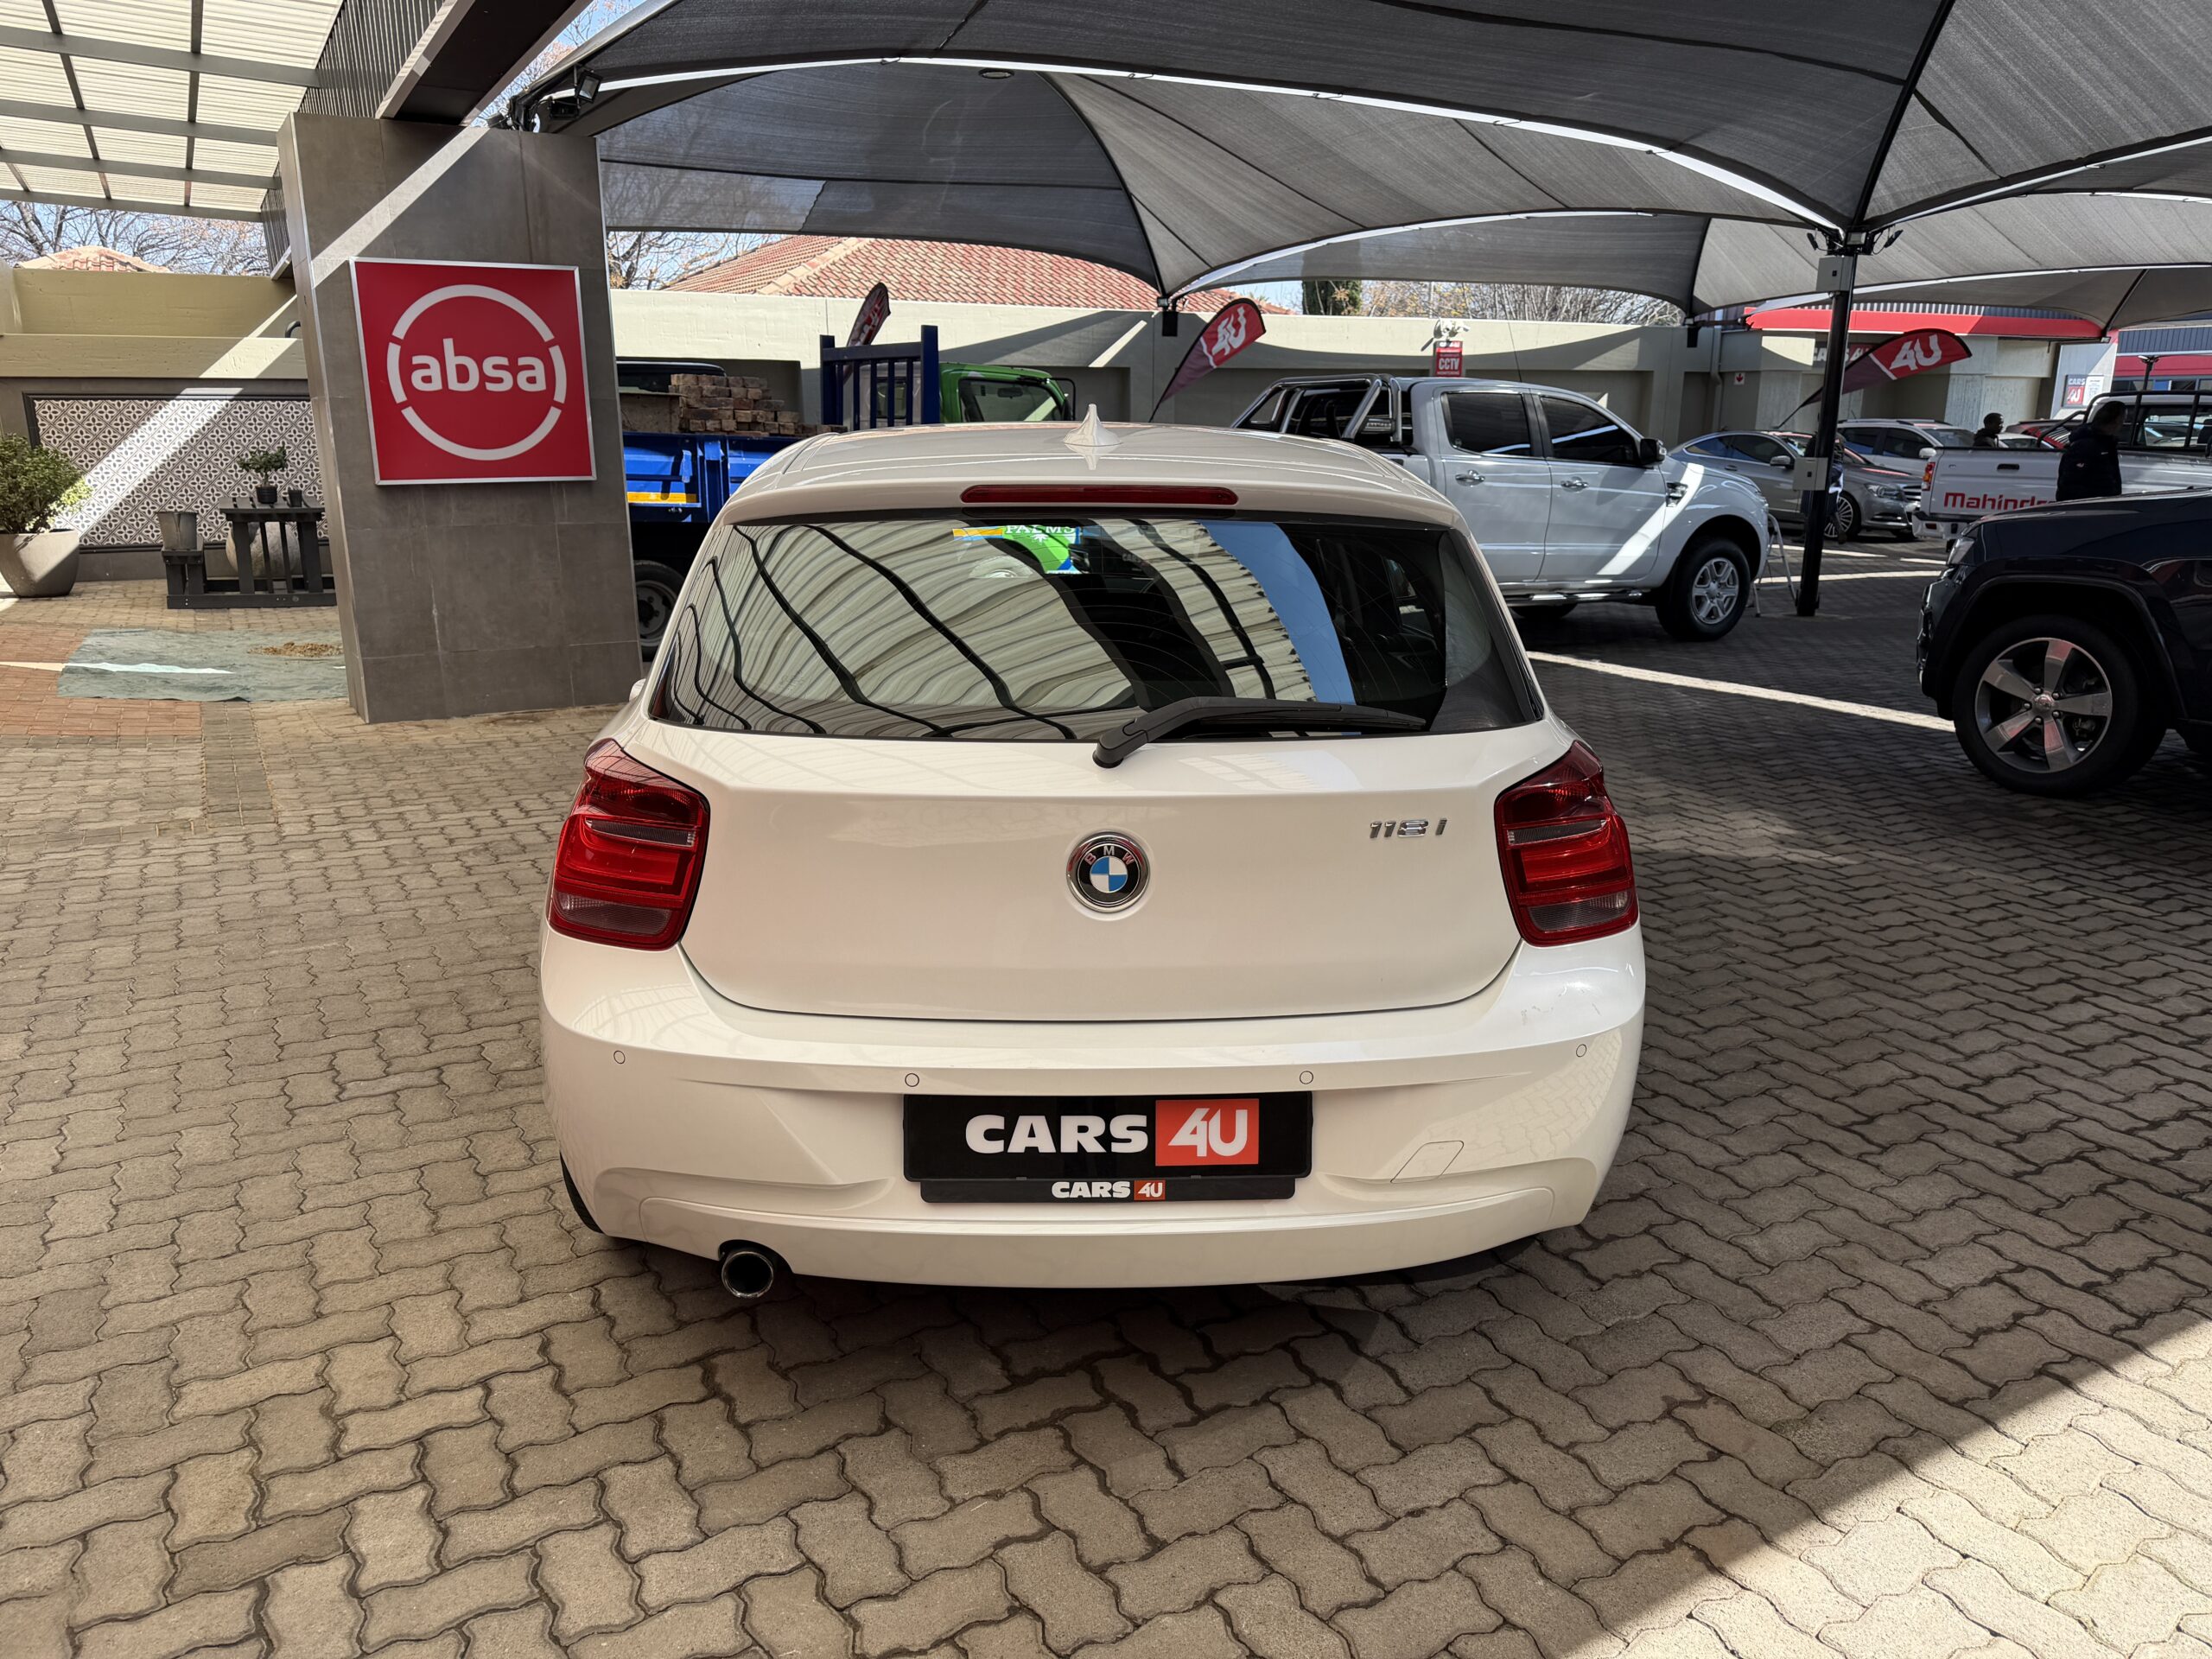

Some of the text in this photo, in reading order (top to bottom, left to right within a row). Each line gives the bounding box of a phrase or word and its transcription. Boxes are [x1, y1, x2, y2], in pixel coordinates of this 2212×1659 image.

[1212, 306, 1246, 356] 4U
[410, 338, 546, 392] absa
[1439, 358, 1460, 370] CCTV
[1890, 334, 1942, 371] 4U
[1084, 845, 1135, 865] BMW
[965, 1108, 1248, 1157] CARS 4U
[1052, 1180, 1164, 1199] CARS 4U
